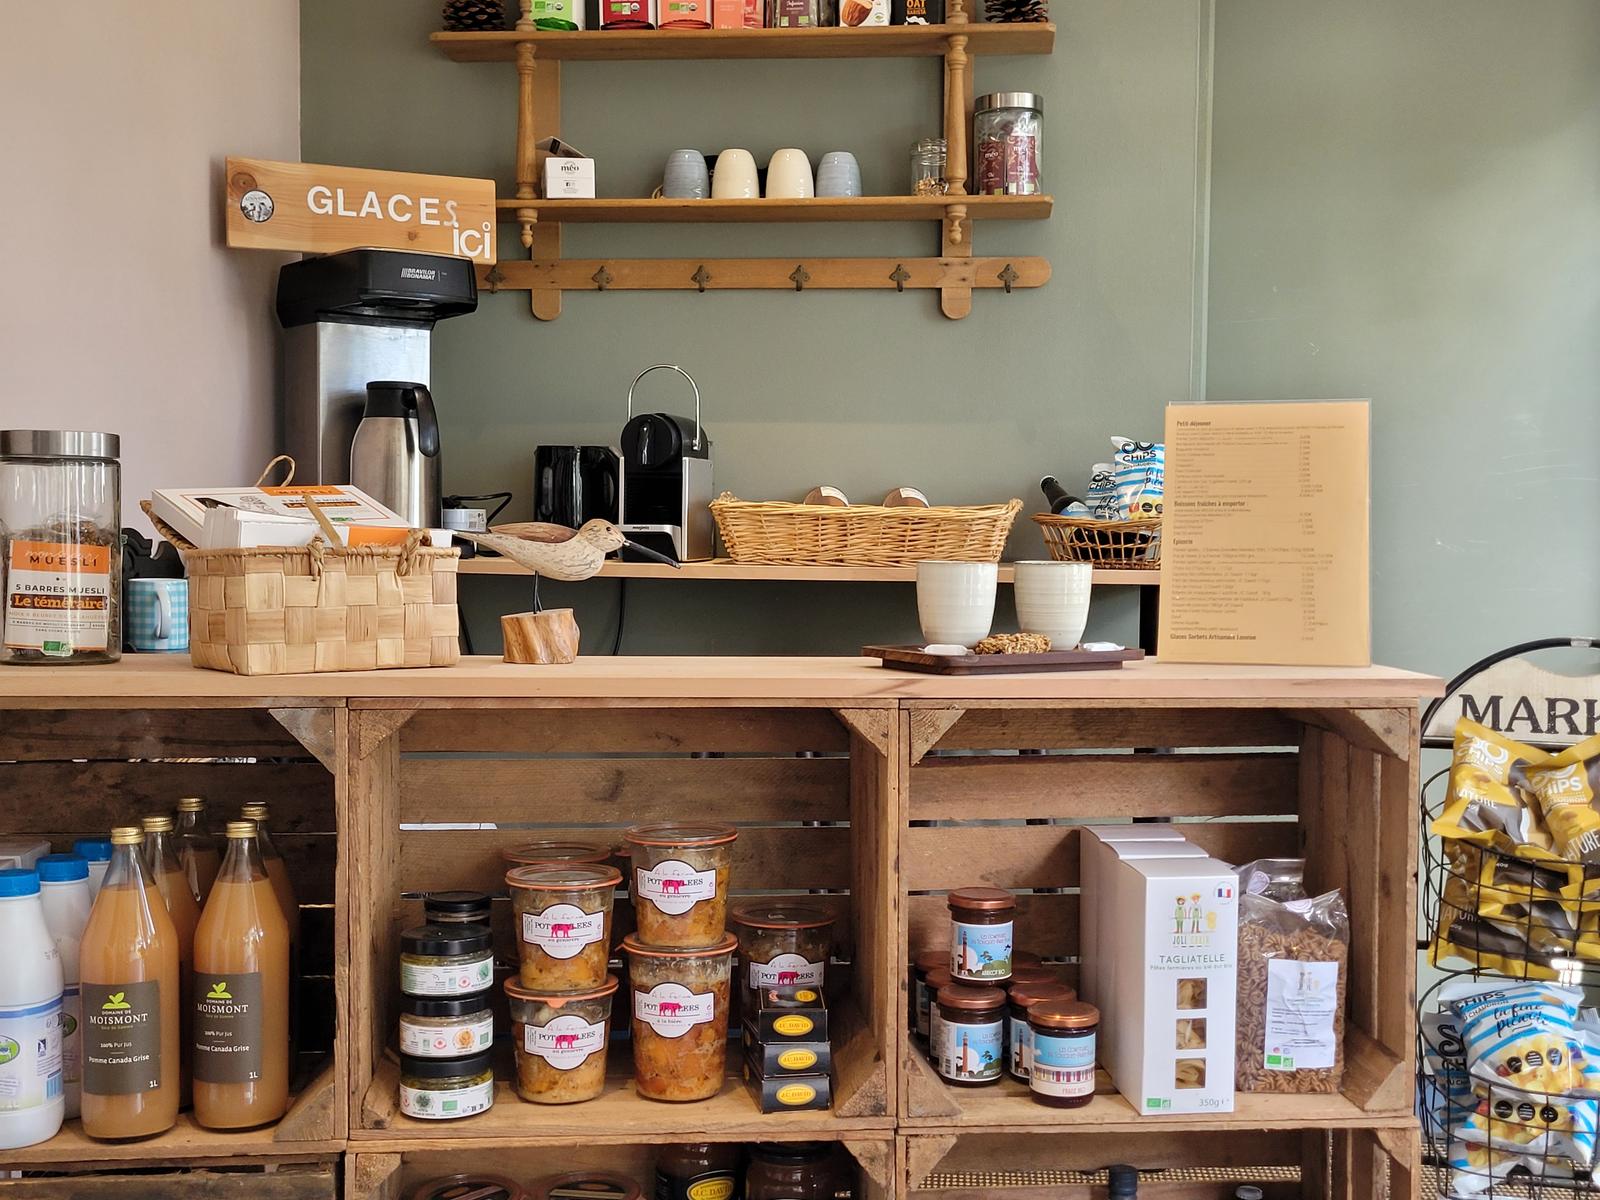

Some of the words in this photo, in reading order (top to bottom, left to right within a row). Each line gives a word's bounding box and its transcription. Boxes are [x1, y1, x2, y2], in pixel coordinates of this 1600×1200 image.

[906, 0, 926, 8] OAT
[1122, 449, 1157, 462] CHIPS
[1089, 481, 1117, 490] CHIPS
[29, 555, 97, 567] MUESLI
[15, 583, 21, 591] 5
[25, 584, 65, 593] BARRES
[69, 587, 105, 595] MUESLI
[14, 594, 32, 607] Le
[34, 596, 105, 609] téméraire
[1159, 953, 1225, 964] TAGLIATELLE
[197, 1003, 249, 1014] MOISMONT
[89, 1013, 149, 1025] MOISMONT
[210, 1045, 233, 1053] Canada
[232, 1045, 250, 1053] Grise
[88, 1056, 108, 1064] Pomme
[108, 1056, 133, 1064] Canada
[132, 1054, 150, 1062] Grise
[248, 1071, 259, 1079] 1L
[149, 1080, 158, 1088] 1L
[1199, 1098, 1220, 1108] 350g
